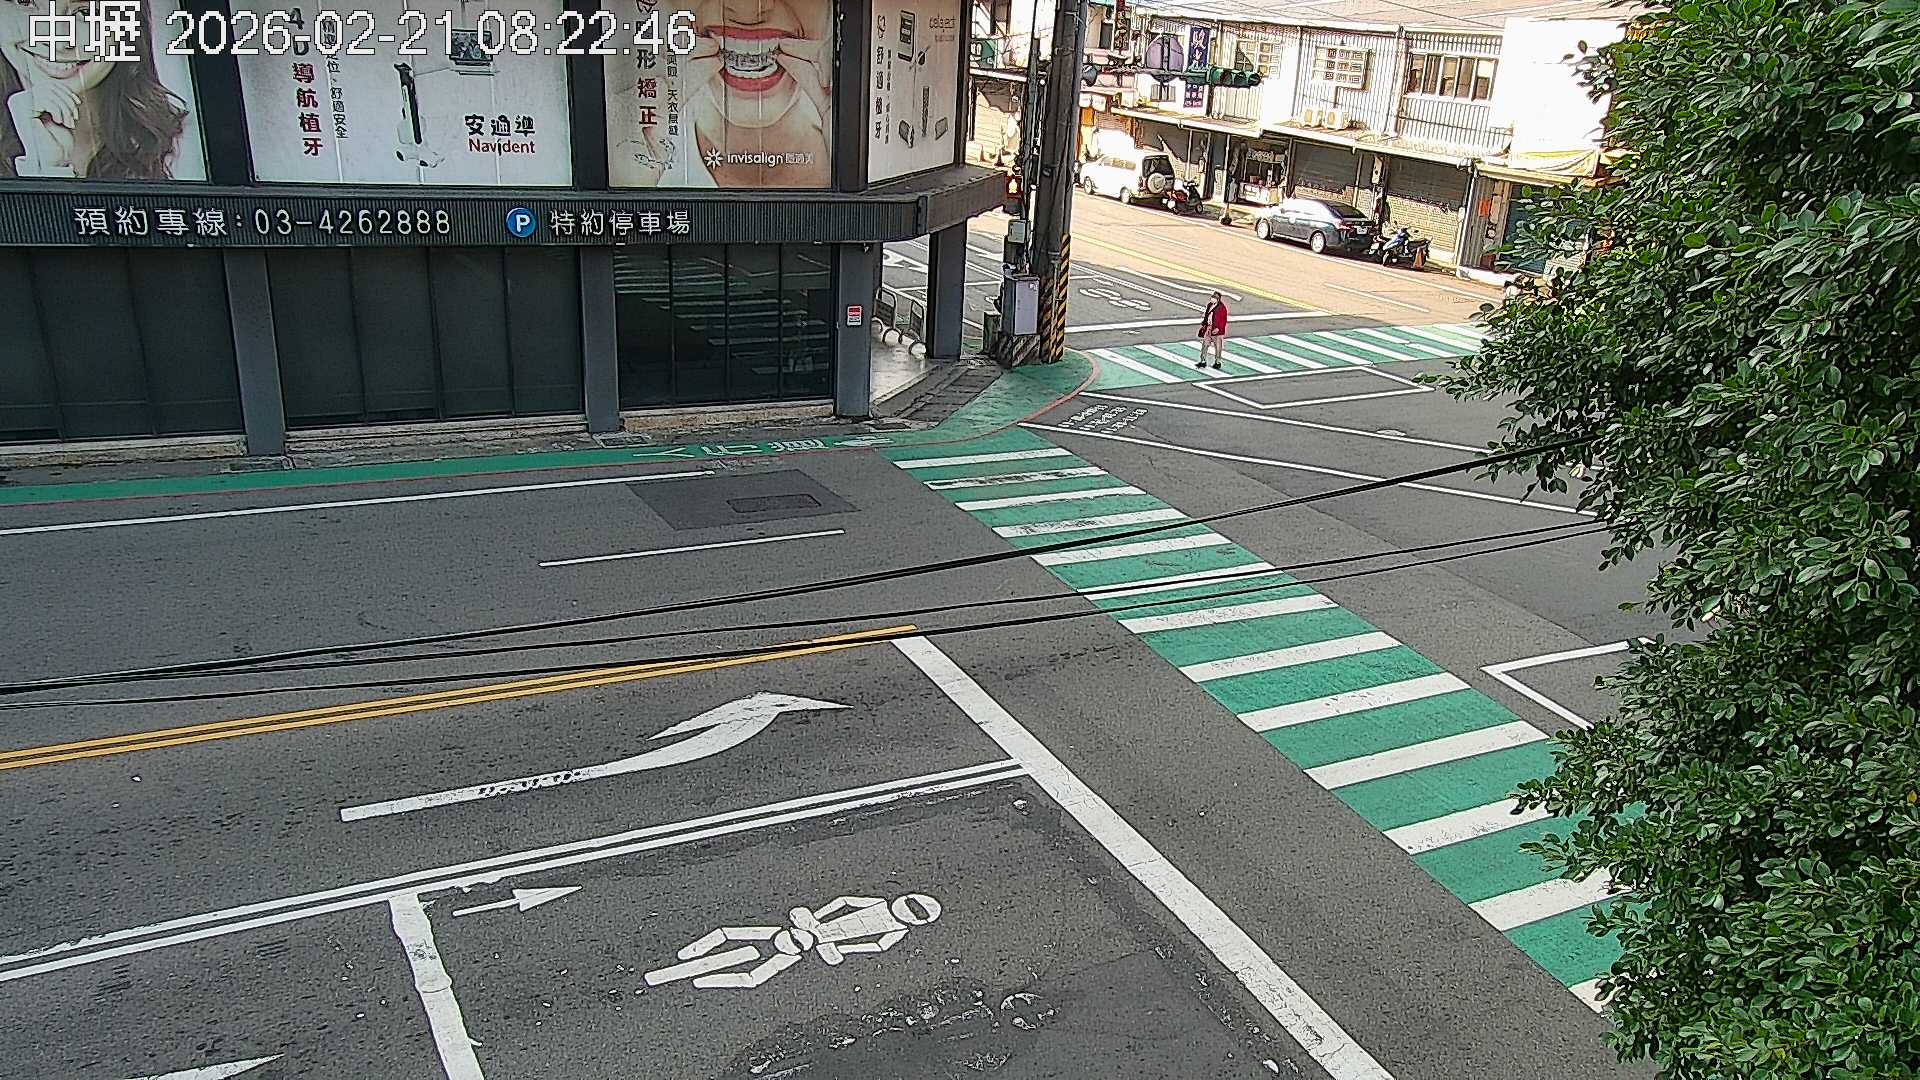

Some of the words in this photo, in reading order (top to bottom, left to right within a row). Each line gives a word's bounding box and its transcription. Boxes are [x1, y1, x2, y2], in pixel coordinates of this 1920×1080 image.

[468, 138, 536, 156] Navident
[727, 151, 784, 167] invisalign
[549, 209, 691, 237] 特約停車場
